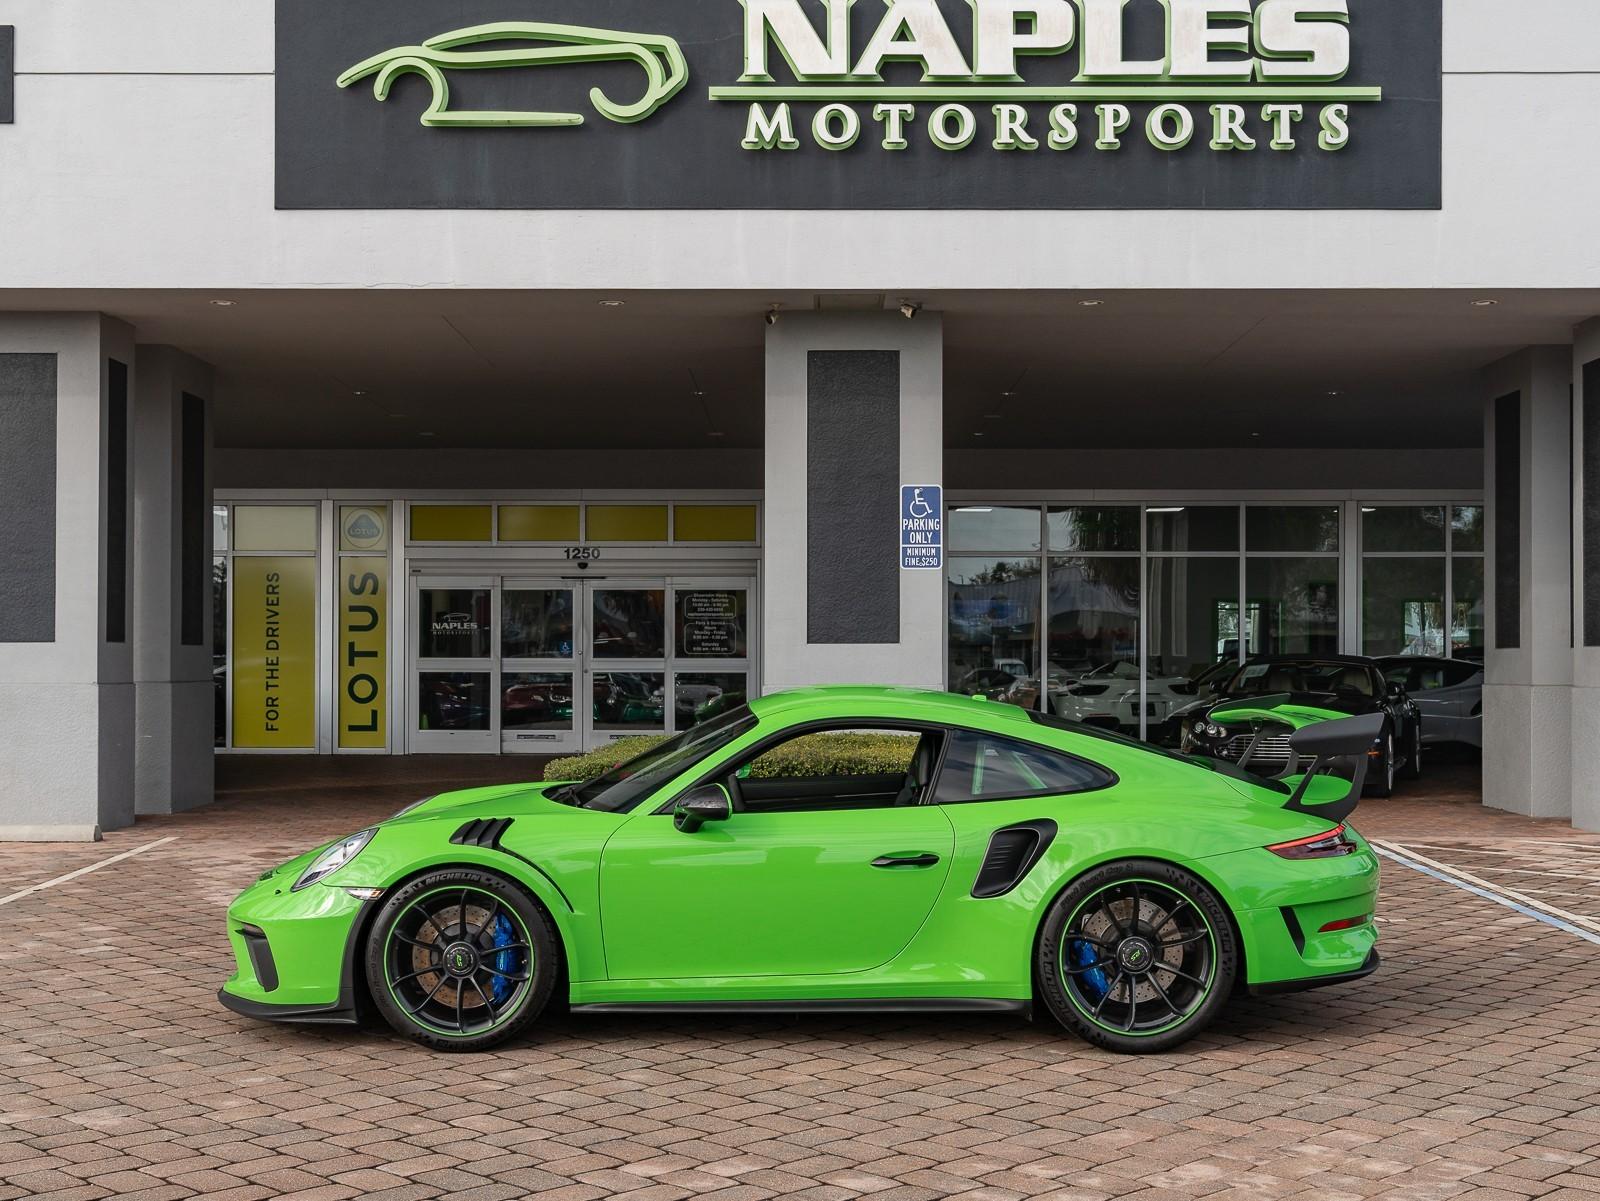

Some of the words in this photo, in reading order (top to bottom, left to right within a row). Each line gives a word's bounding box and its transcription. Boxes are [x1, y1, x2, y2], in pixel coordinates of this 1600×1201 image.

[736, 0, 1350, 82] NAPLES
[741, 102, 1349, 150] MOTORSPORTS
[903, 519, 940, 530] PARKING
[910, 532, 932, 543] ONLY
[564, 547, 600, 560] 1250
[905, 558, 920, 566] FINE
[921, 557, 938, 566] $250
[907, 548, 936, 556] MINIMUM
[266, 572, 280, 651] DRIVERS
[432, 622, 478, 630] NAPLES
[348, 572, 379, 731] LOTUS
[266, 656, 279, 691] THE
[266, 697, 279, 731] FOR
[426, 872, 481, 885] MICHELIN
[1199, 891, 1232, 953] MICHELIN
